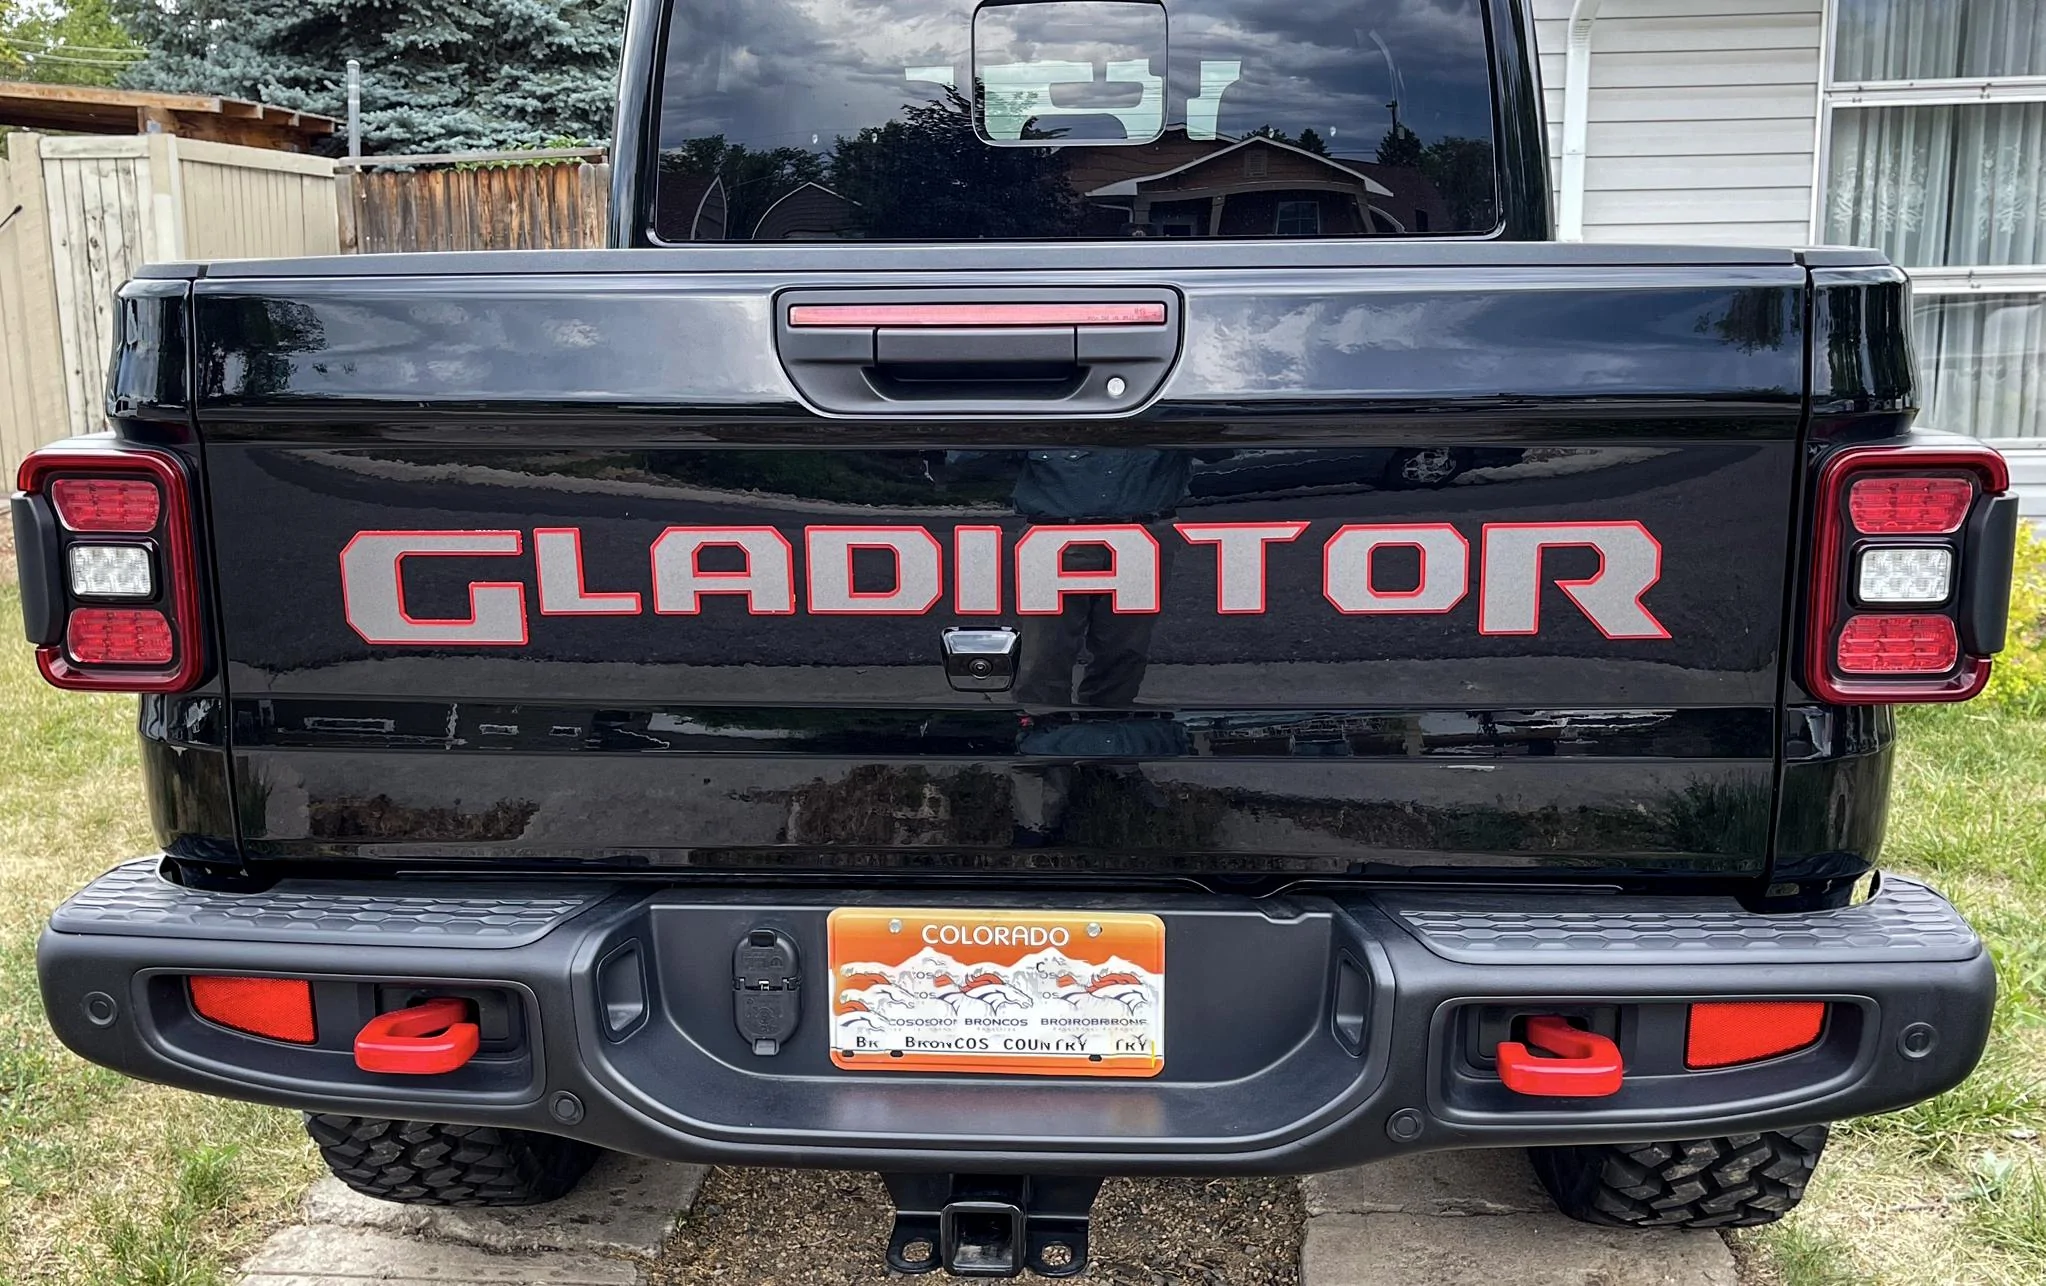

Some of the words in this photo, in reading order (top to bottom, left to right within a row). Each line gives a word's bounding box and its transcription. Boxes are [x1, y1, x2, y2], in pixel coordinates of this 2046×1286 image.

[340, 520, 1672, 645] GLADIATOR
[921, 924, 1070, 947] COLORADO
[964, 1018, 1029, 1027] BRONCOS
